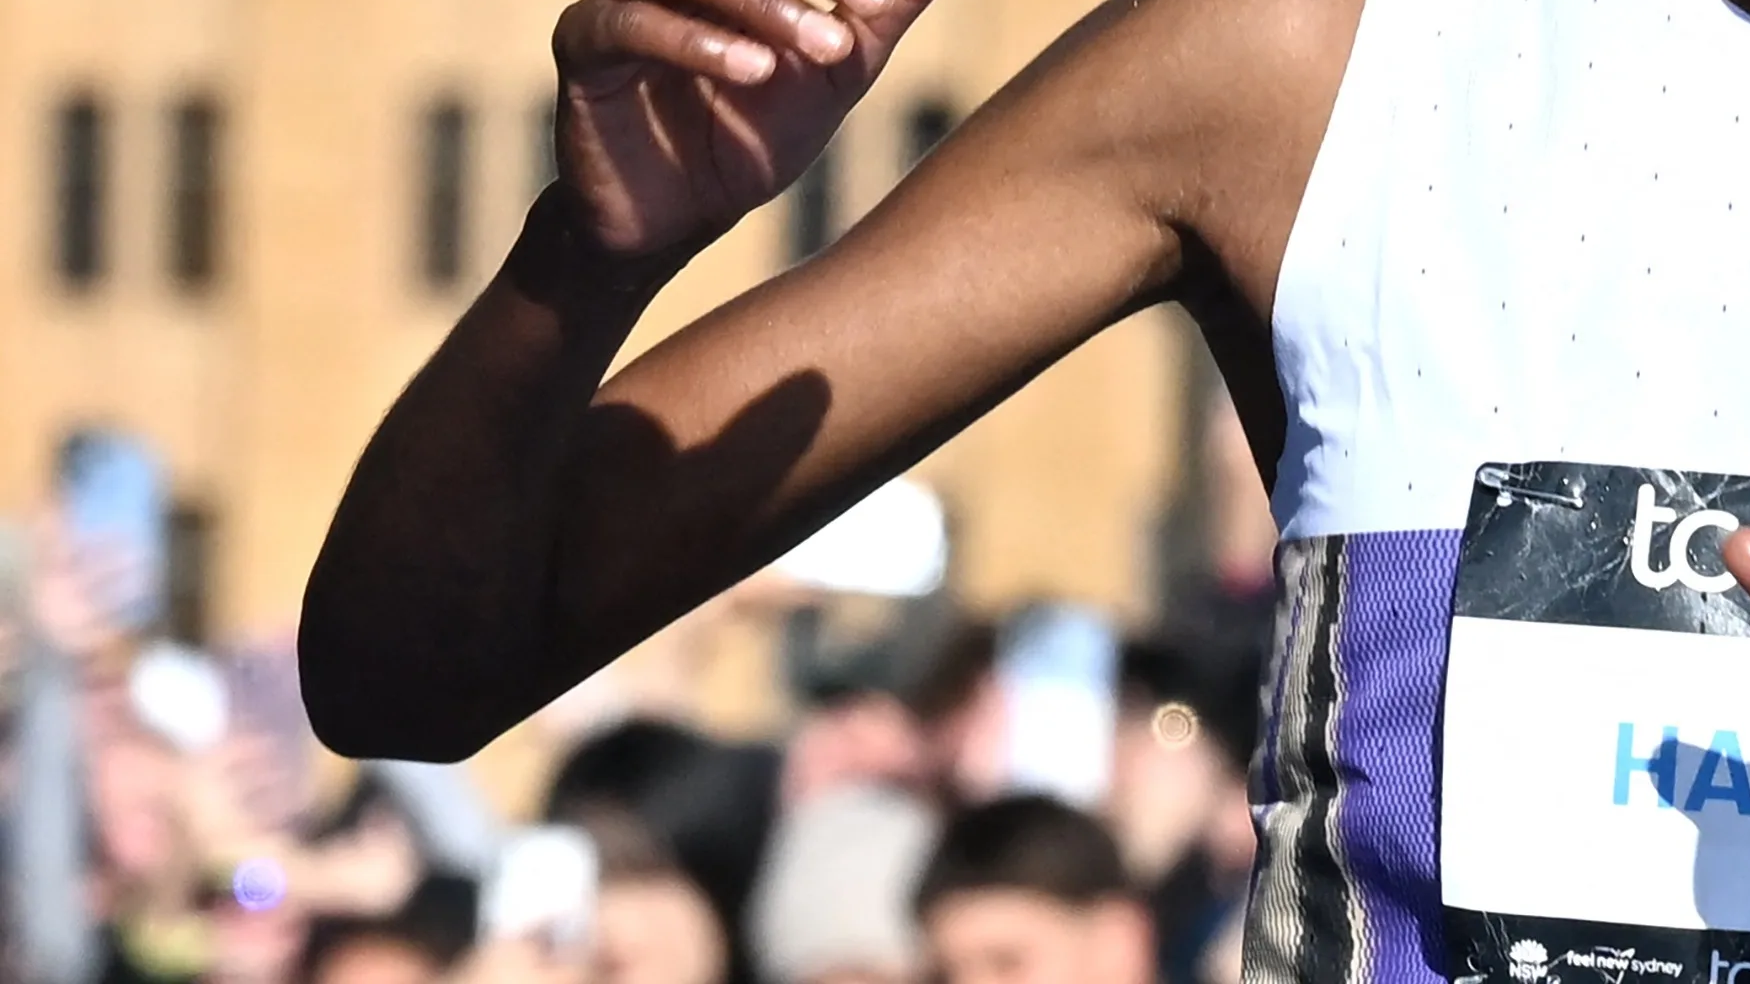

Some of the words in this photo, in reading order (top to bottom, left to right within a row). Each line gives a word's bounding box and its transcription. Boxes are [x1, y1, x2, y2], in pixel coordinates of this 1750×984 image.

[1509, 962, 1548, 981] NSW
[1567, 950, 1594, 968] feel
[1597, 956, 1629, 971] new
[1631, 958, 1683, 978] sydney
